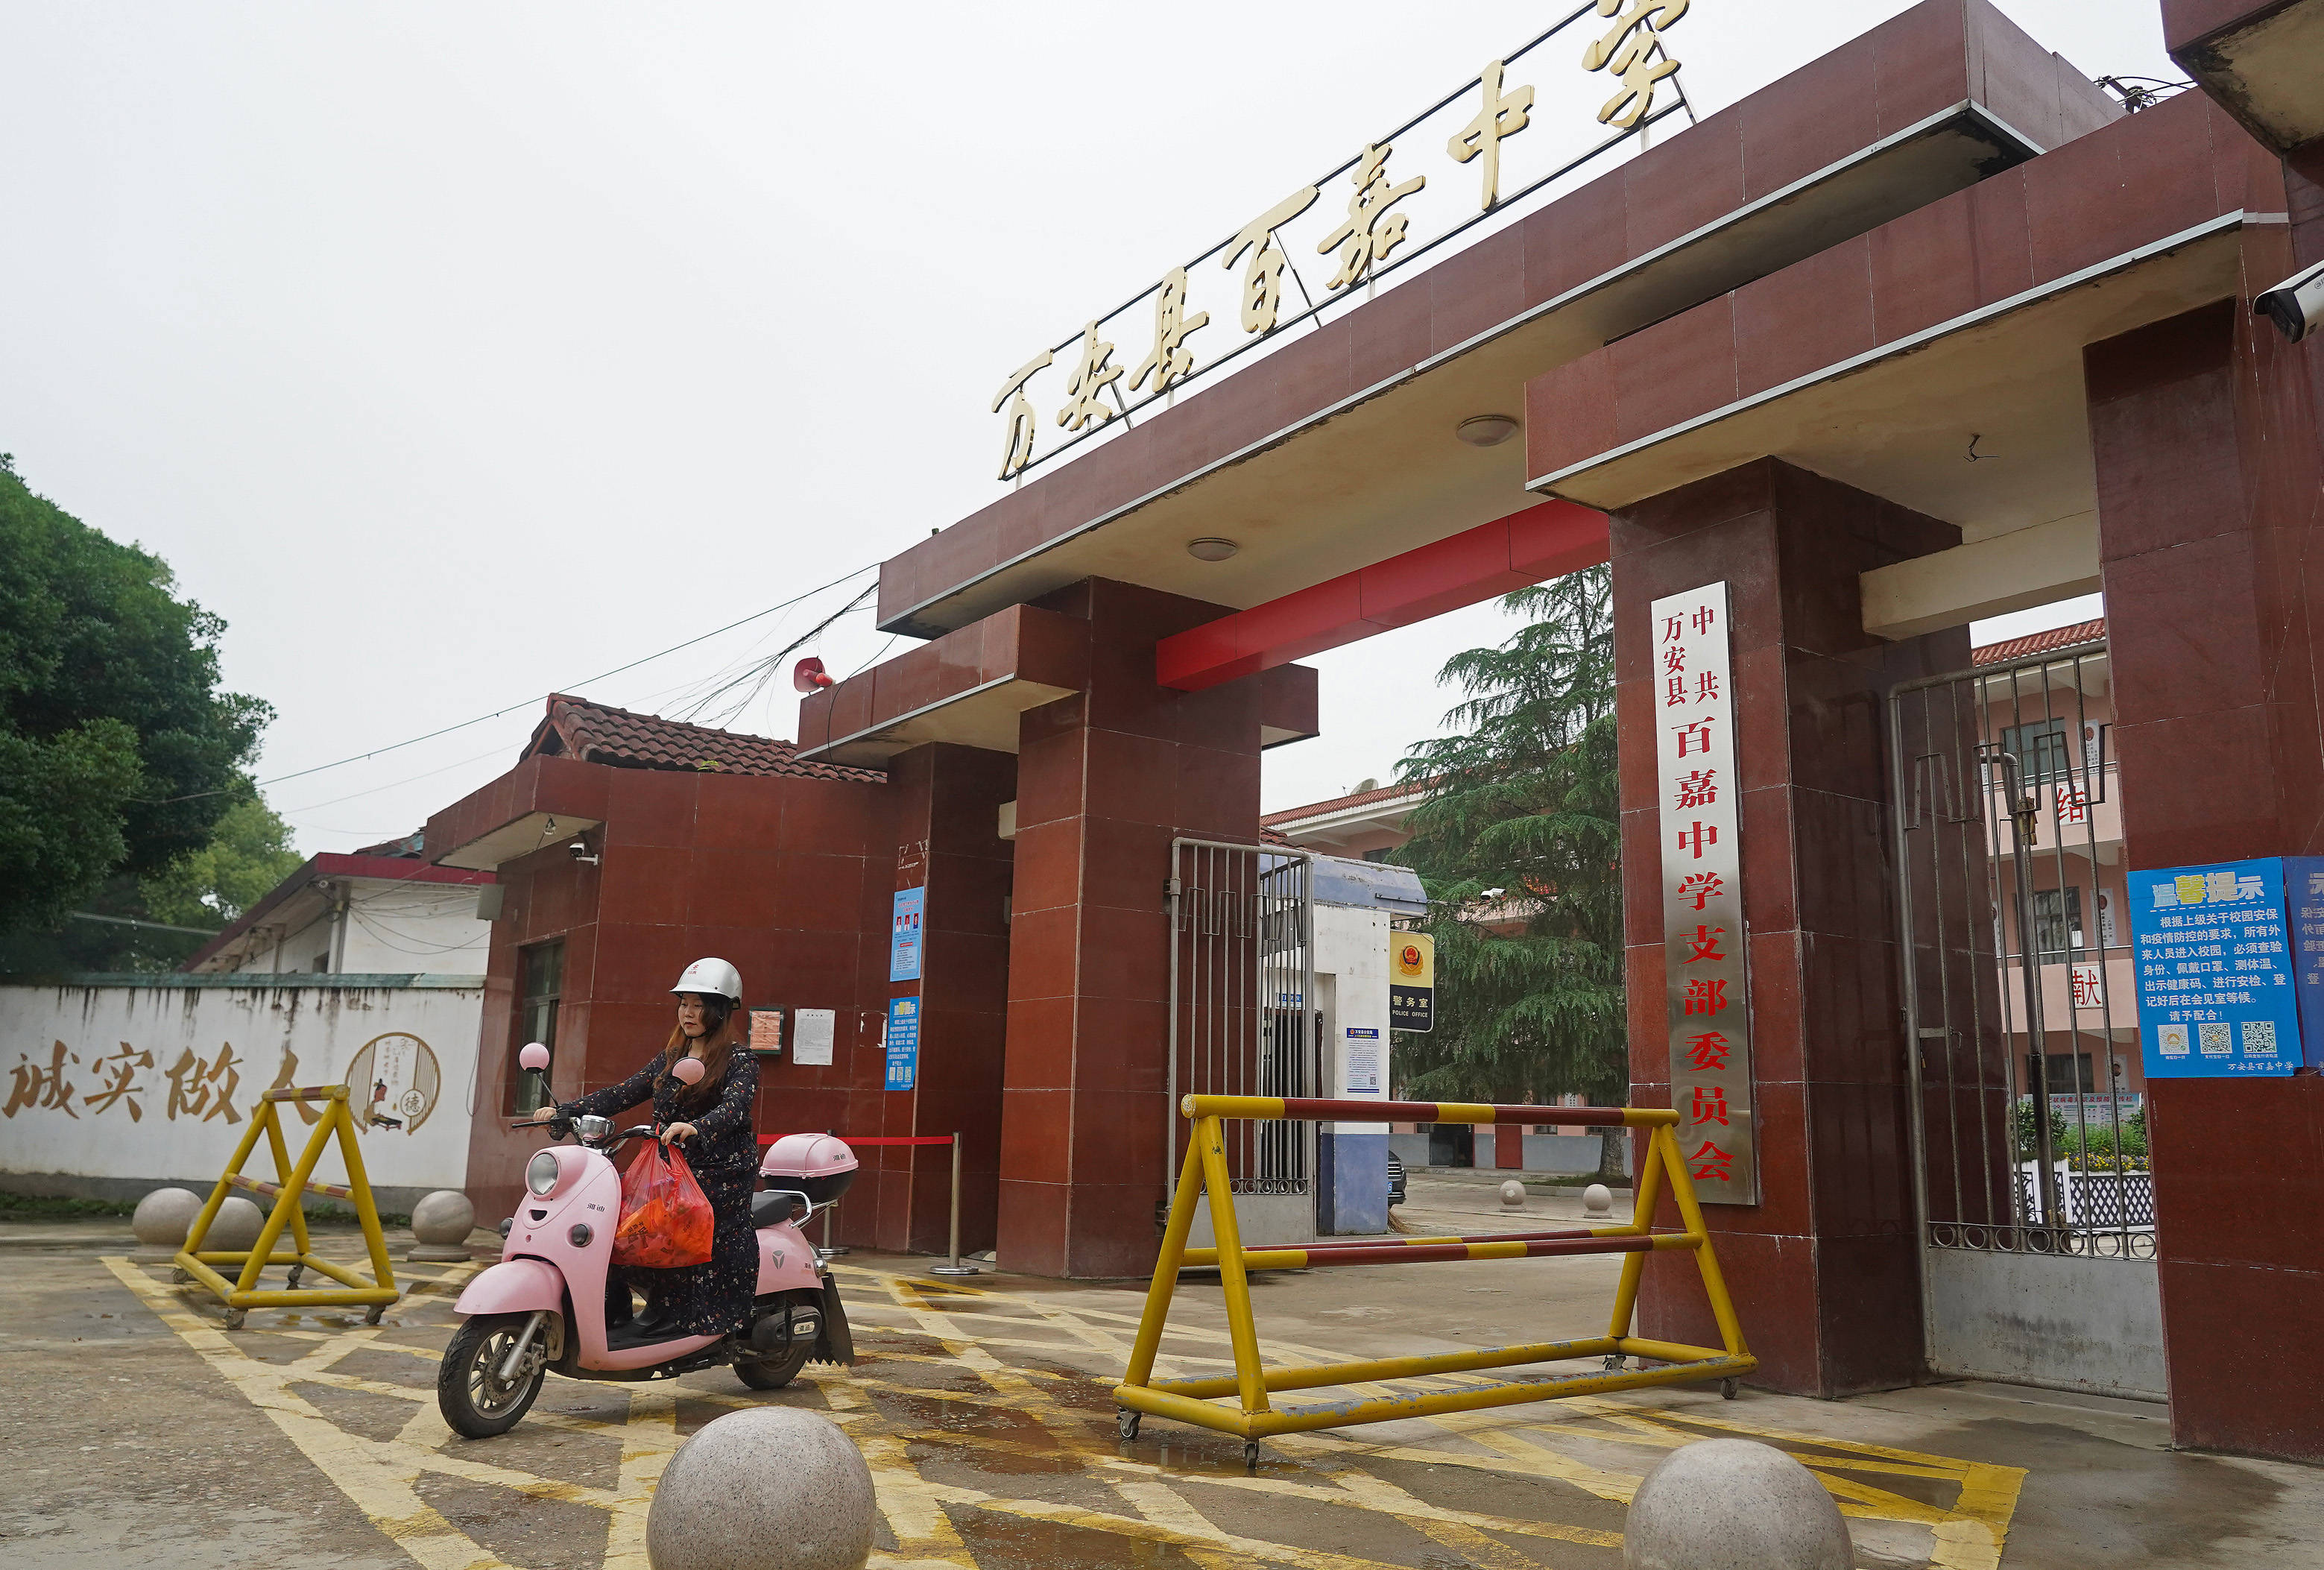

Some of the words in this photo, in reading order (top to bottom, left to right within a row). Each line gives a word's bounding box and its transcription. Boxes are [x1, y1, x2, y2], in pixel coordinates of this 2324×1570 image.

[1661, 611, 1688, 708] 万安县
[1692, 605, 1720, 704] 中共
[2152, 871, 2264, 907] 温馨提示
[2160, 908, 2279, 928] 根据上级关于校园安保
[1670, 716, 1736, 1182] 百嘉中学支部委员会
[1393, 995, 1428, 1008] 警务室
[2145, 992, 2257, 1007] 记好后在会见室等候。
[1, 1039, 324, 1126] 诚实做人
[2227, 1062, 2293, 1071] 万安县百嘉中学
